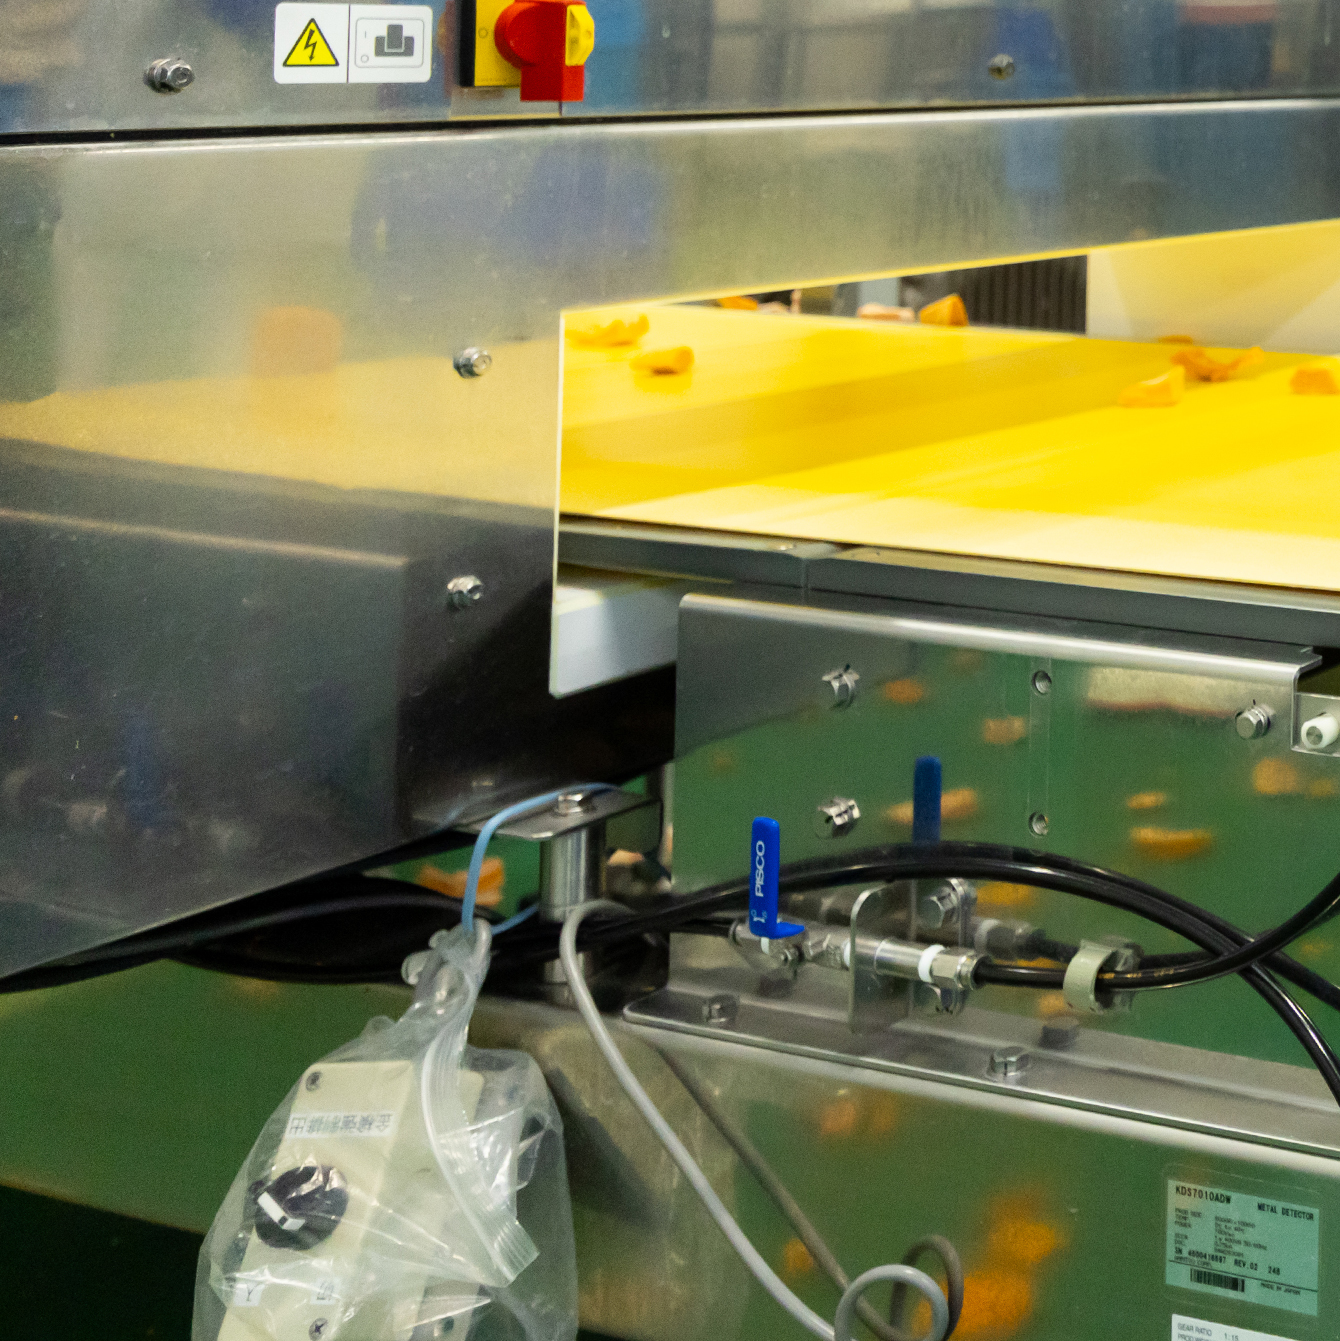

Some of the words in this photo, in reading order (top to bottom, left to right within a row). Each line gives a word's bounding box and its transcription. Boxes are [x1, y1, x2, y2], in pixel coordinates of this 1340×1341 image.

[755, 840, 765, 897] PISCO
[1257, 1202, 1278, 1214] METAL
[1281, 1207, 1315, 1221] DETECTOR
